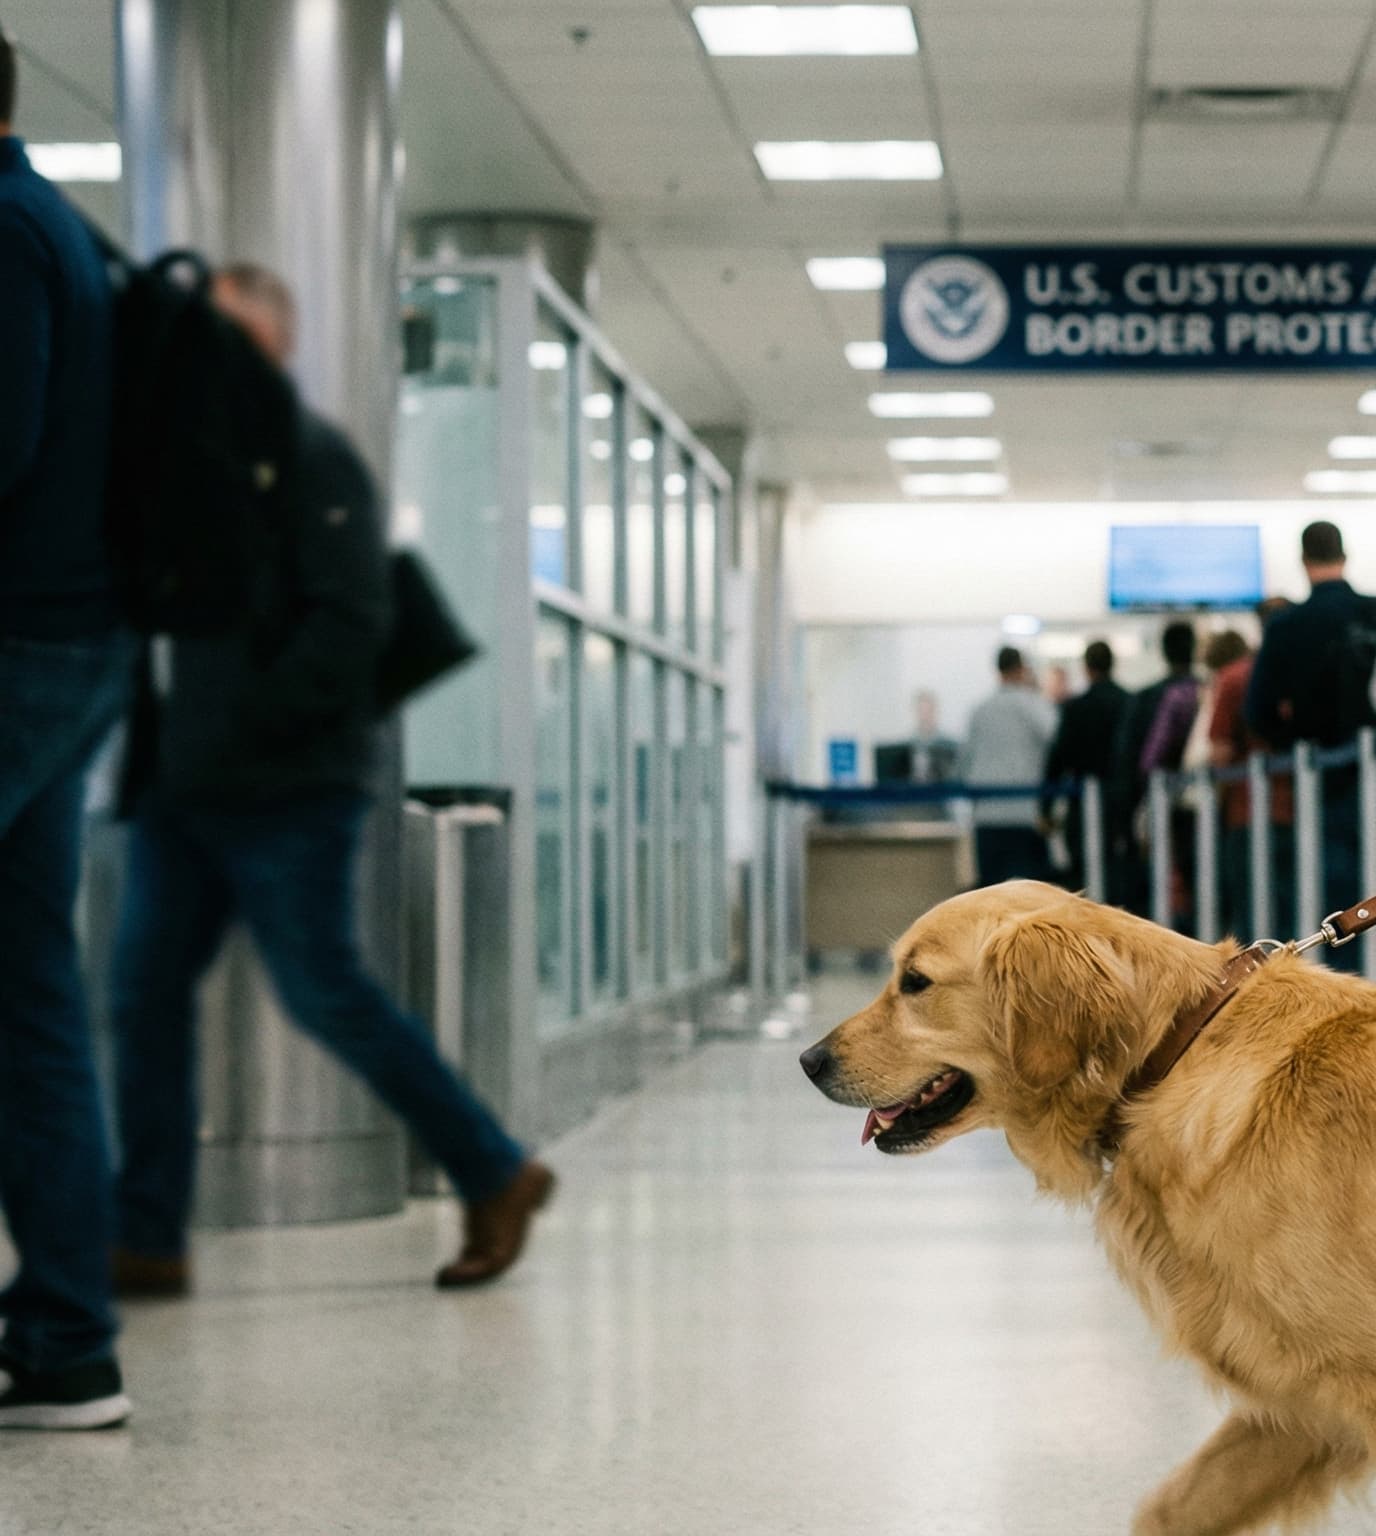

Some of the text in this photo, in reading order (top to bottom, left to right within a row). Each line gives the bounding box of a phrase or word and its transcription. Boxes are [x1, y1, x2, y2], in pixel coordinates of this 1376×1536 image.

[1024, 262, 1110, 304] U.S.
[1123, 262, 1351, 304] CUSTOMS
[1024, 312, 1214, 355] BORDER
